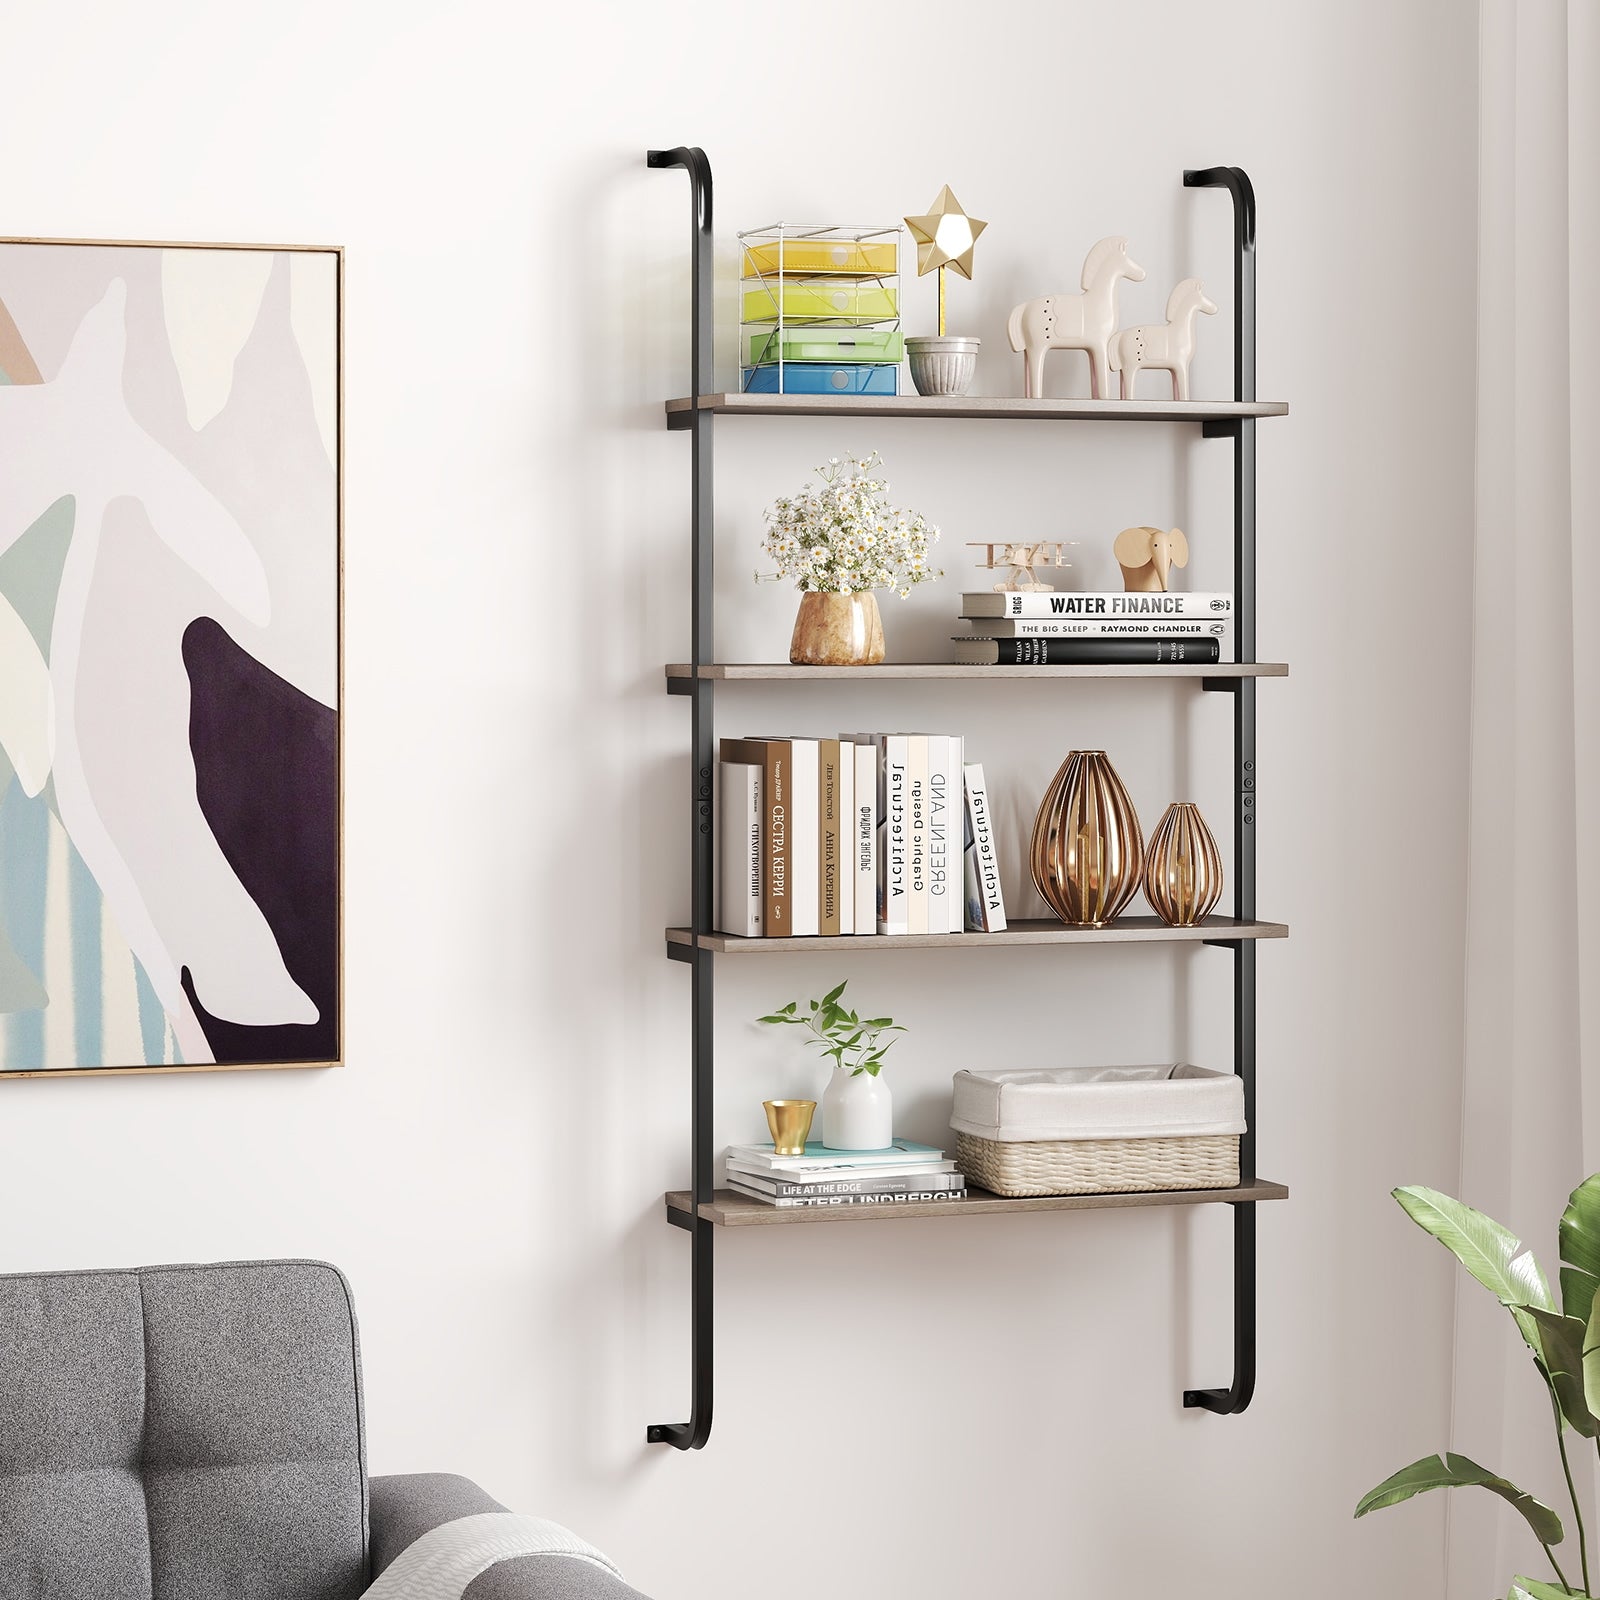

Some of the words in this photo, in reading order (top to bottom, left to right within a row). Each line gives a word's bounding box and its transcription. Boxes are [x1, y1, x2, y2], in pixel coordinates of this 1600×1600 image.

[1012, 596, 1022, 614] GRIGG
[1050, 597, 1106, 614] WATER
[1112, 597, 1184, 614] FINANCE
[1101, 625, 1149, 633] RAYMOND
[1152, 625, 1202, 633] CHANDLER
[772, 805, 785, 853] СЕСТРА
[860, 806, 871, 839] ФРИДРИХ
[860, 842, 871, 871] ЭНГЕЛЬС
[772, 857, 785, 896] КЕРРИ
[783, 1184, 802, 1195] LIFE
[804, 1184, 815, 1194] AT
[817, 1184, 835, 1193] THE
[837, 1183, 862, 1192] EDGE
